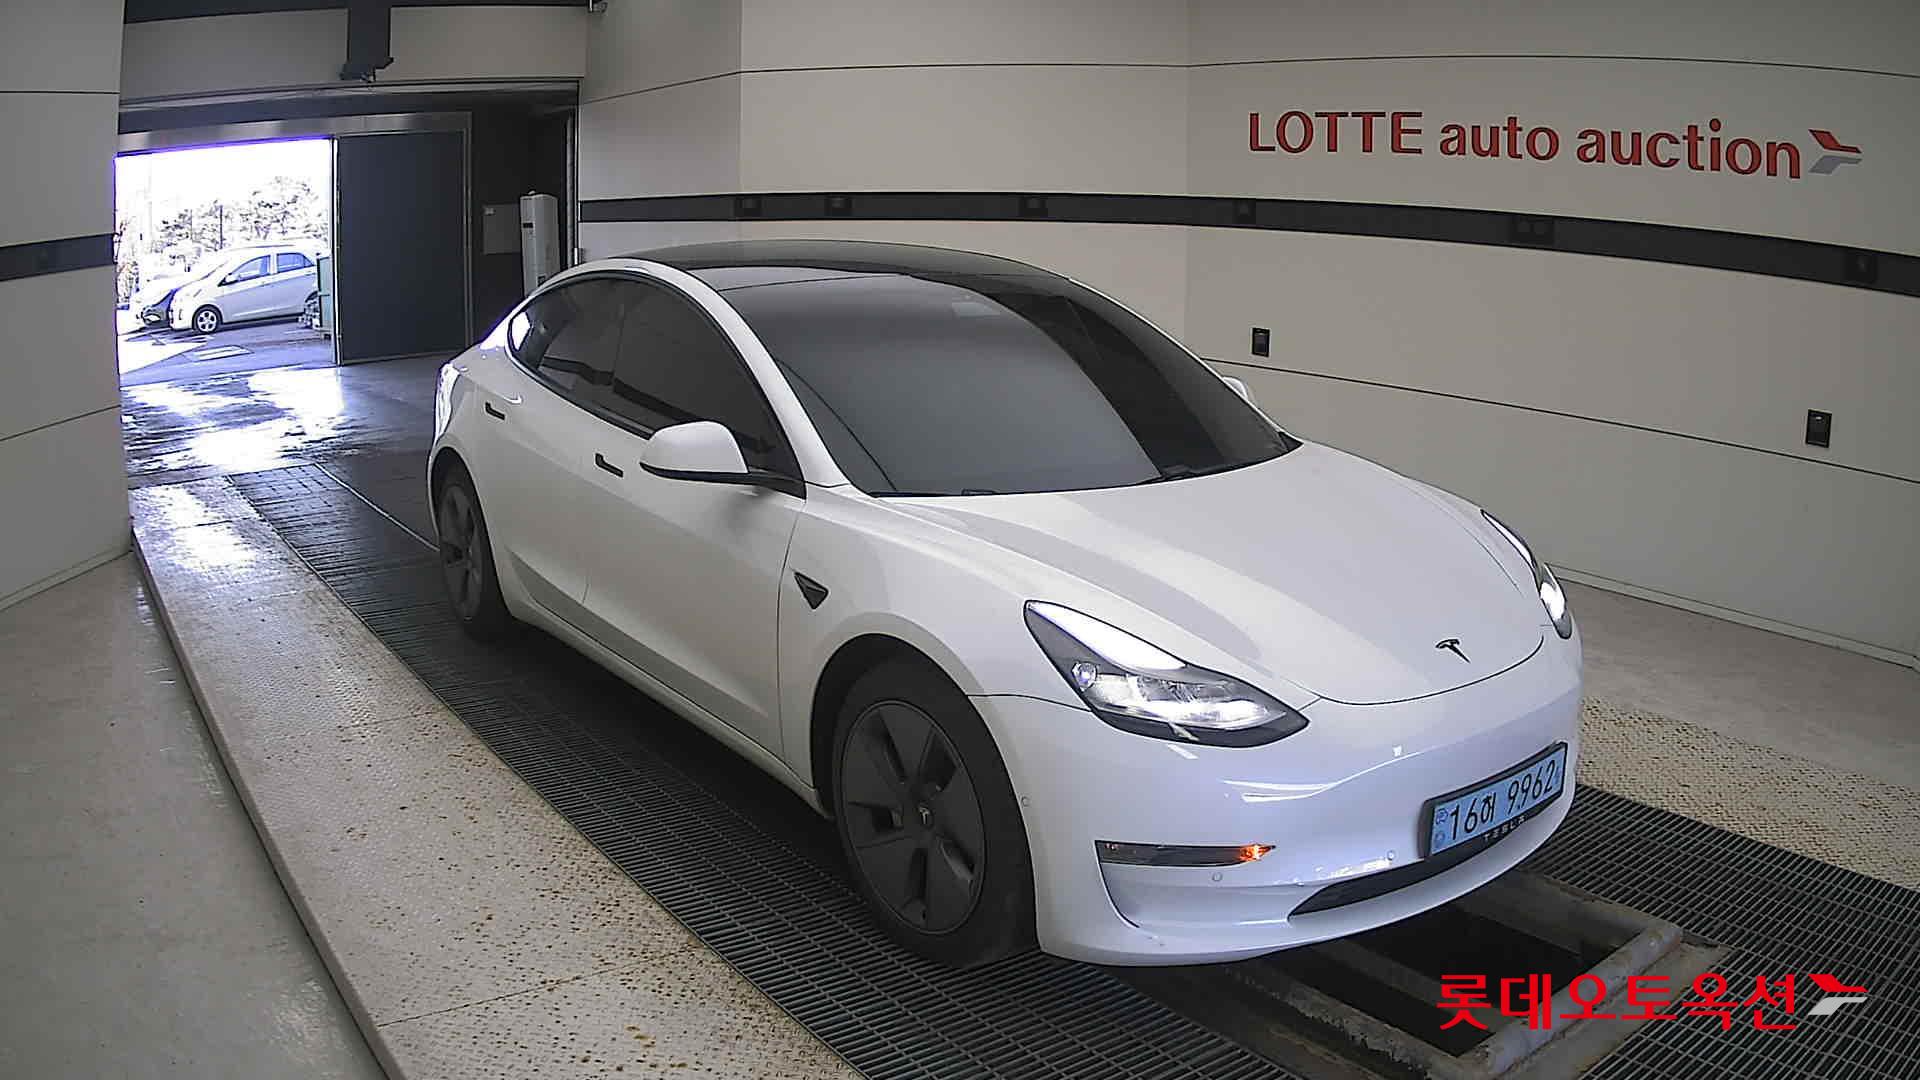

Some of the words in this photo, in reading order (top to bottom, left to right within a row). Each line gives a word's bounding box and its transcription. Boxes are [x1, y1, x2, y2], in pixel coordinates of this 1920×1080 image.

[1248, 110, 1423, 154] LOTTE
[1439, 116, 1560, 161] auto
[1576, 118, 1801, 179] auction
[1450, 792, 1496, 840] 16허
[1508, 760, 1555, 815] 9962
[1483, 815, 1526, 842] TESLA
